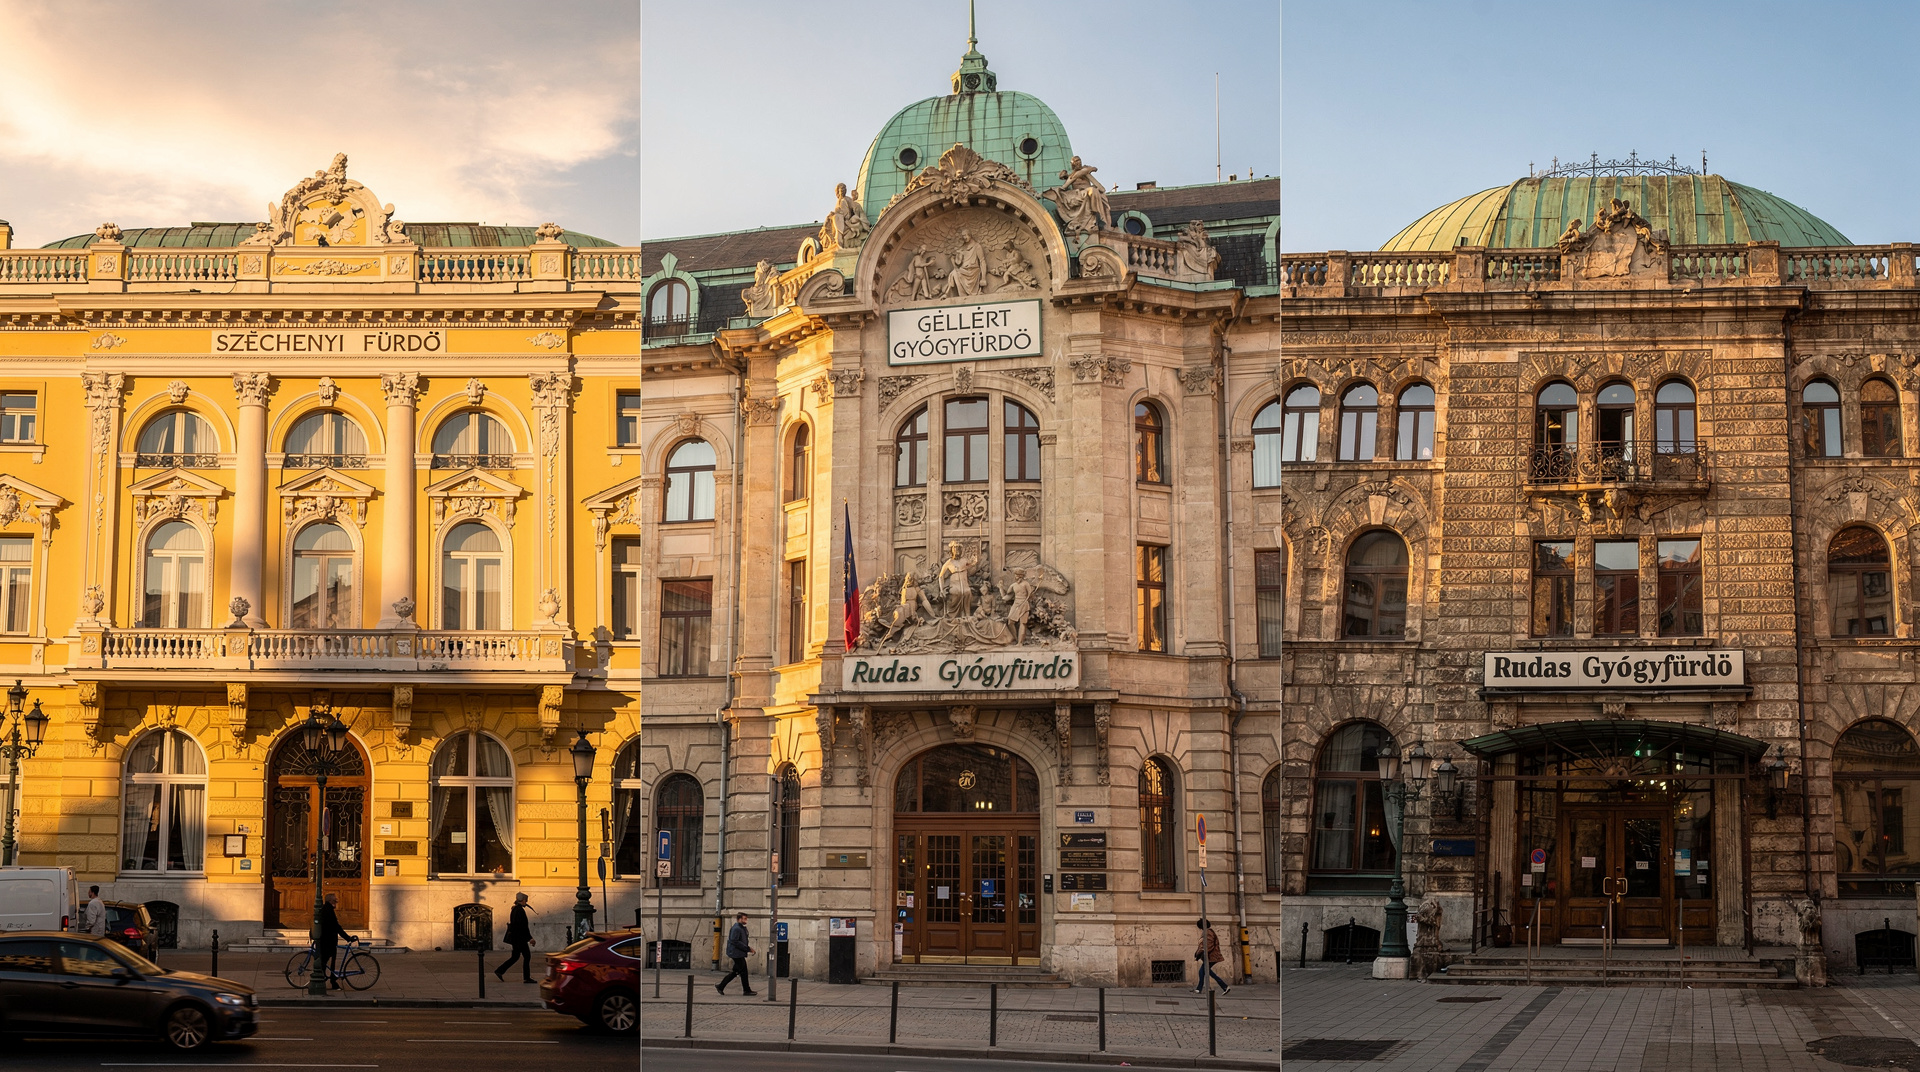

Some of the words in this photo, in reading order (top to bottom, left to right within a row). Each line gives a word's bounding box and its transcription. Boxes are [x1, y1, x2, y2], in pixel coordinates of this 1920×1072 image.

[363, 331, 441, 352] FÜRDÖ
[893, 328, 1032, 359] GYÓGYFÜRDÖ
[851, 659, 921, 683] Rudas
[1493, 656, 1572, 678] Rudas
[1582, 654, 1733, 684] Gyógyfürdö
